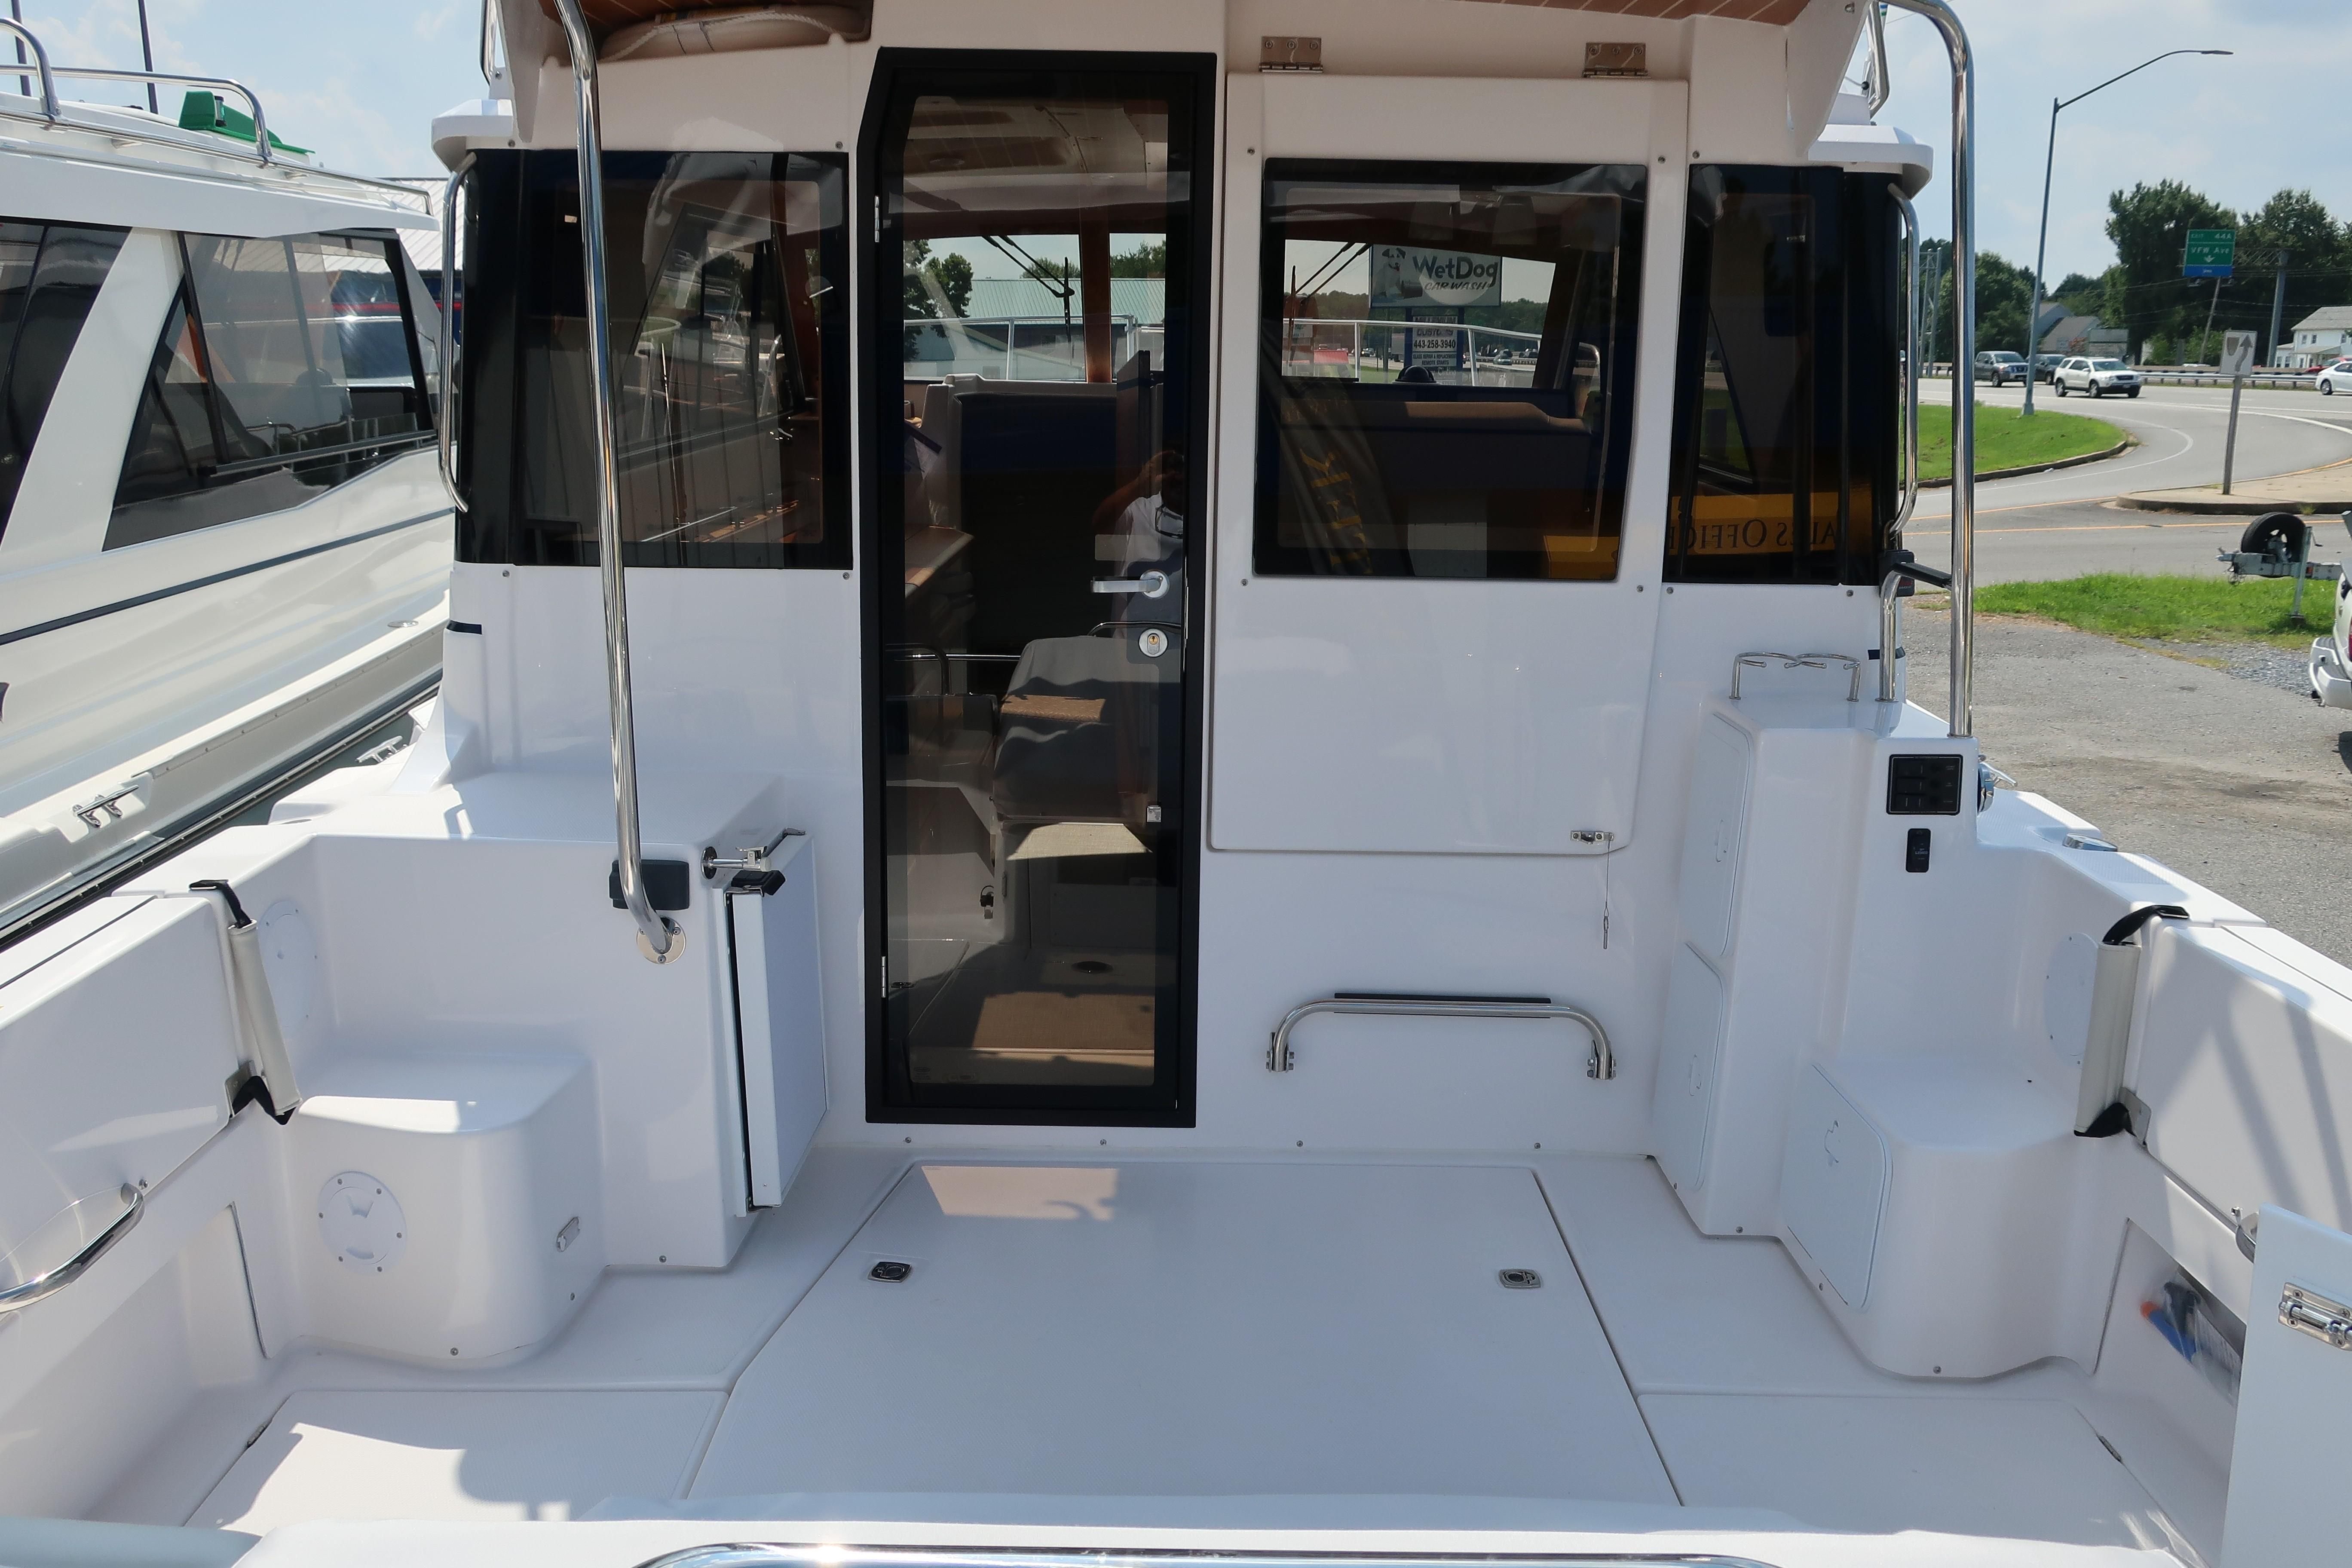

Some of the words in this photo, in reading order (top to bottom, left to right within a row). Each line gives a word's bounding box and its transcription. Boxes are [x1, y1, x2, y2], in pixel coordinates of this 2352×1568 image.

[1412, 255, 1499, 288] WetDog
[1424, 282, 1449, 290] CAR
[1450, 282, 1488, 290] WASH
[1414, 339, 1456, 349] 443-258-3940
